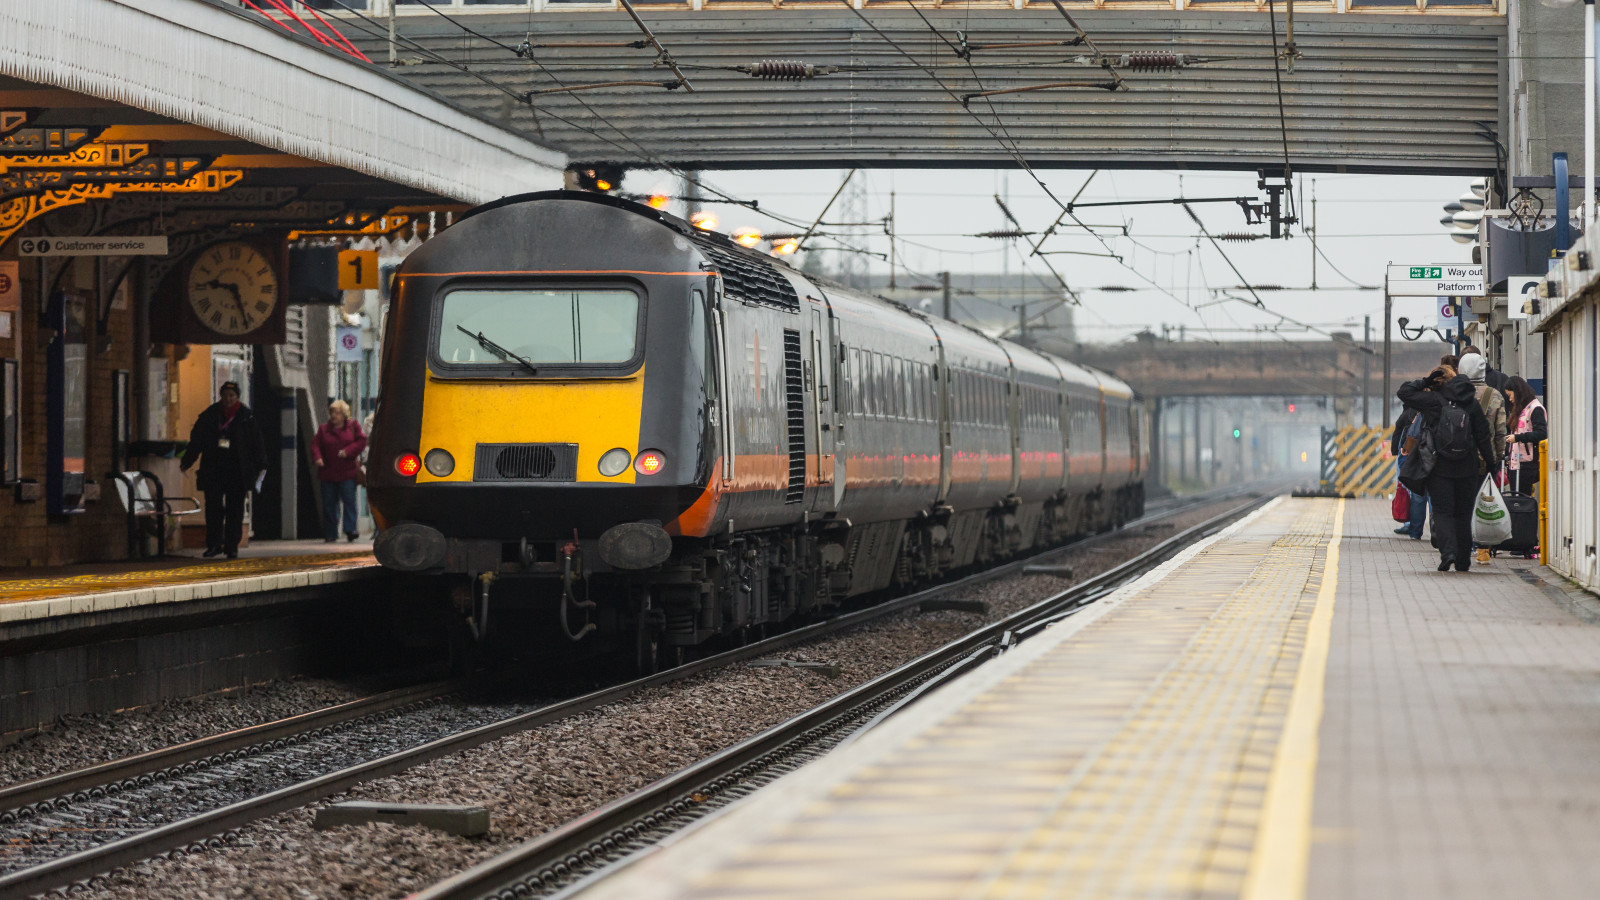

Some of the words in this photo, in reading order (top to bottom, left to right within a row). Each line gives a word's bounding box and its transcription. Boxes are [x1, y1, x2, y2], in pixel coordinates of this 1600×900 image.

[55, 240, 106, 251] Customer
[107, 240, 145, 250] service
[348, 256, 362, 284] 1
[1447, 268, 1467, 278] Way
[1468, 268, 1483, 276] out
[1437, 283, 1476, 291] Platform
[1478, 283, 1482, 291] 1
